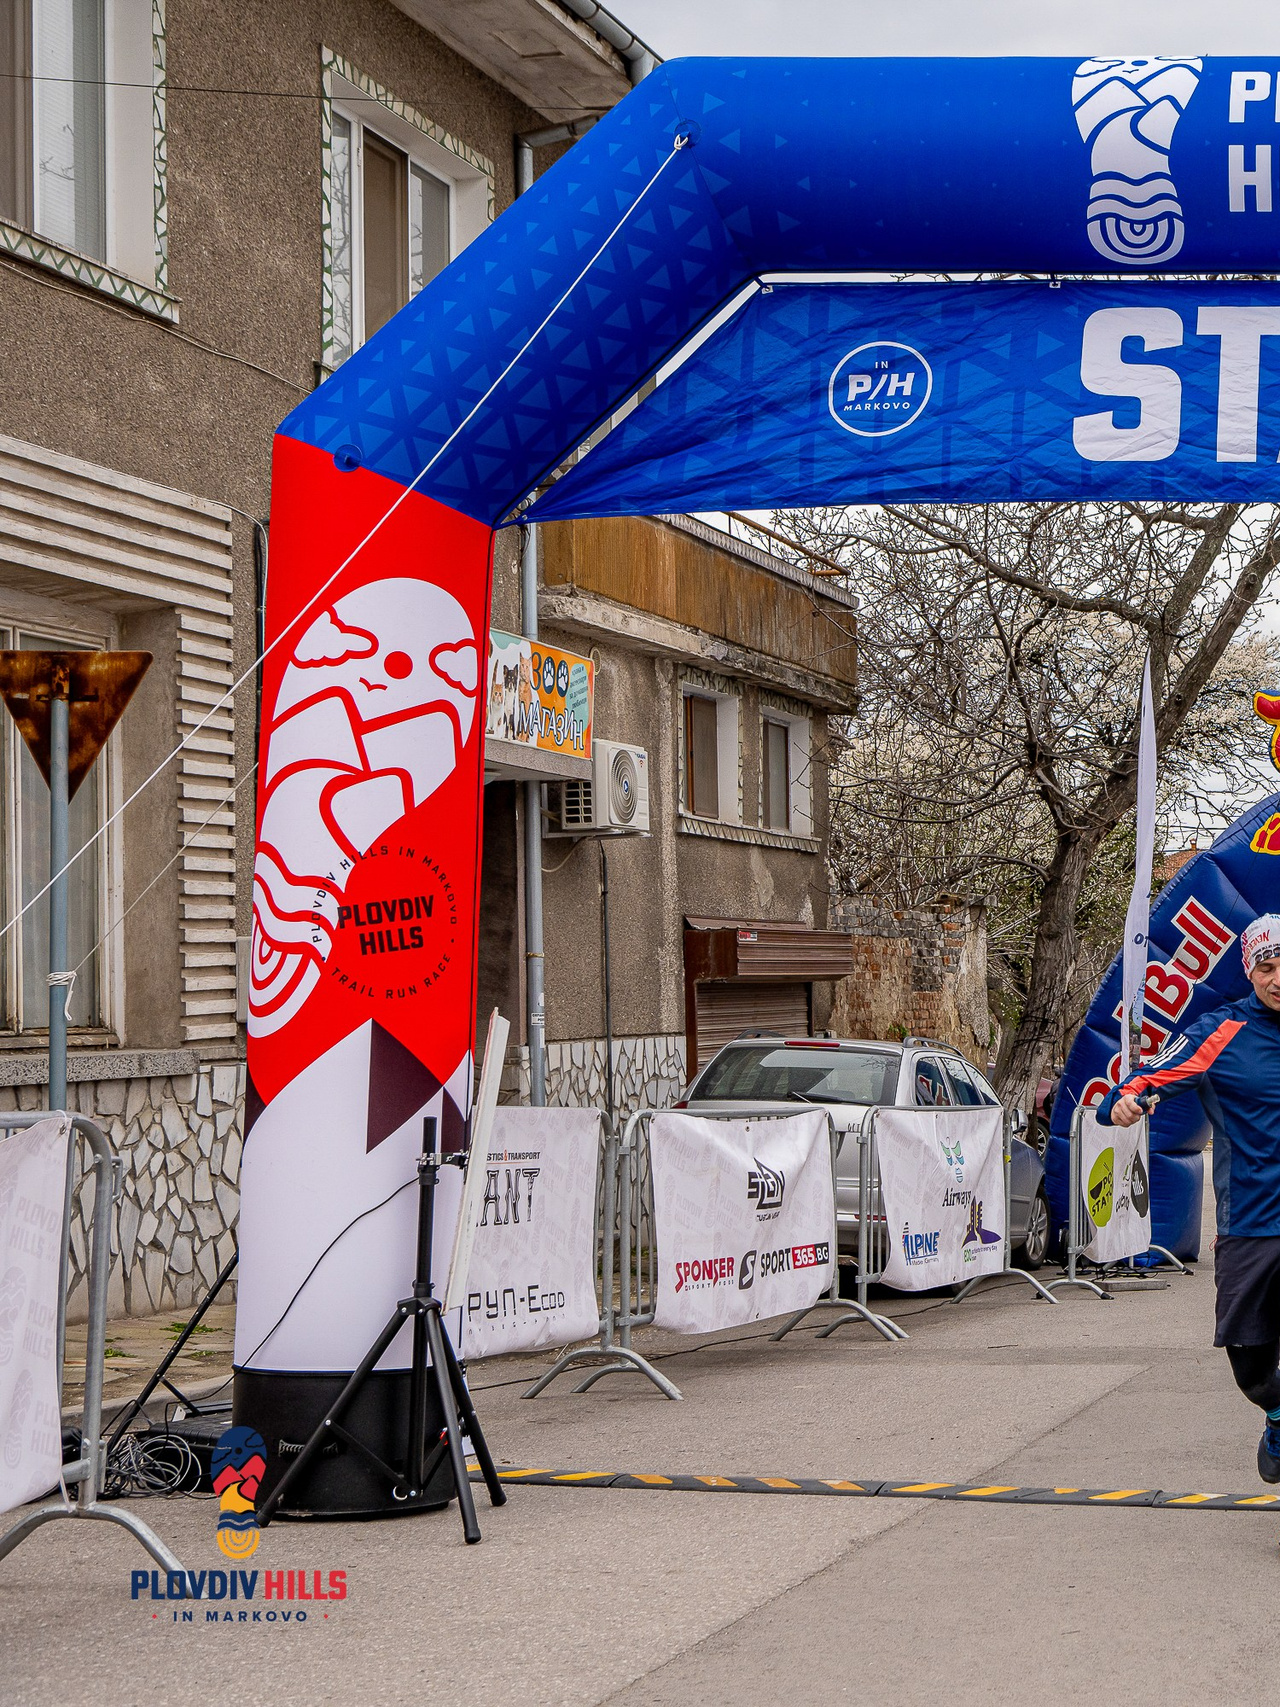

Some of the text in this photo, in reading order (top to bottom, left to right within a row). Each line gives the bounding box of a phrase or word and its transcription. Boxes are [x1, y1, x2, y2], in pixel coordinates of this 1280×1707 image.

[875, 361, 888, 369] IN
[847, 372, 915, 401] P/H
[843, 402, 911, 411] MARKOVO
[519, 700, 584, 750] МАГАЗИН
[313, 845, 457, 943] PLOVDIV HILLS IN MARKOVO
[337, 894, 434, 929] PLOVDIV
[359, 926, 424, 956] HILLS
[331, 953, 450, 999] TRAIL RUN RACE
[508, 1152, 541, 1160] TRANSPORT
[476, 1168, 540, 1227] ANT
[942, 1187, 972, 1209] Airways
[675, 1257, 734, 1293] SPONSER
